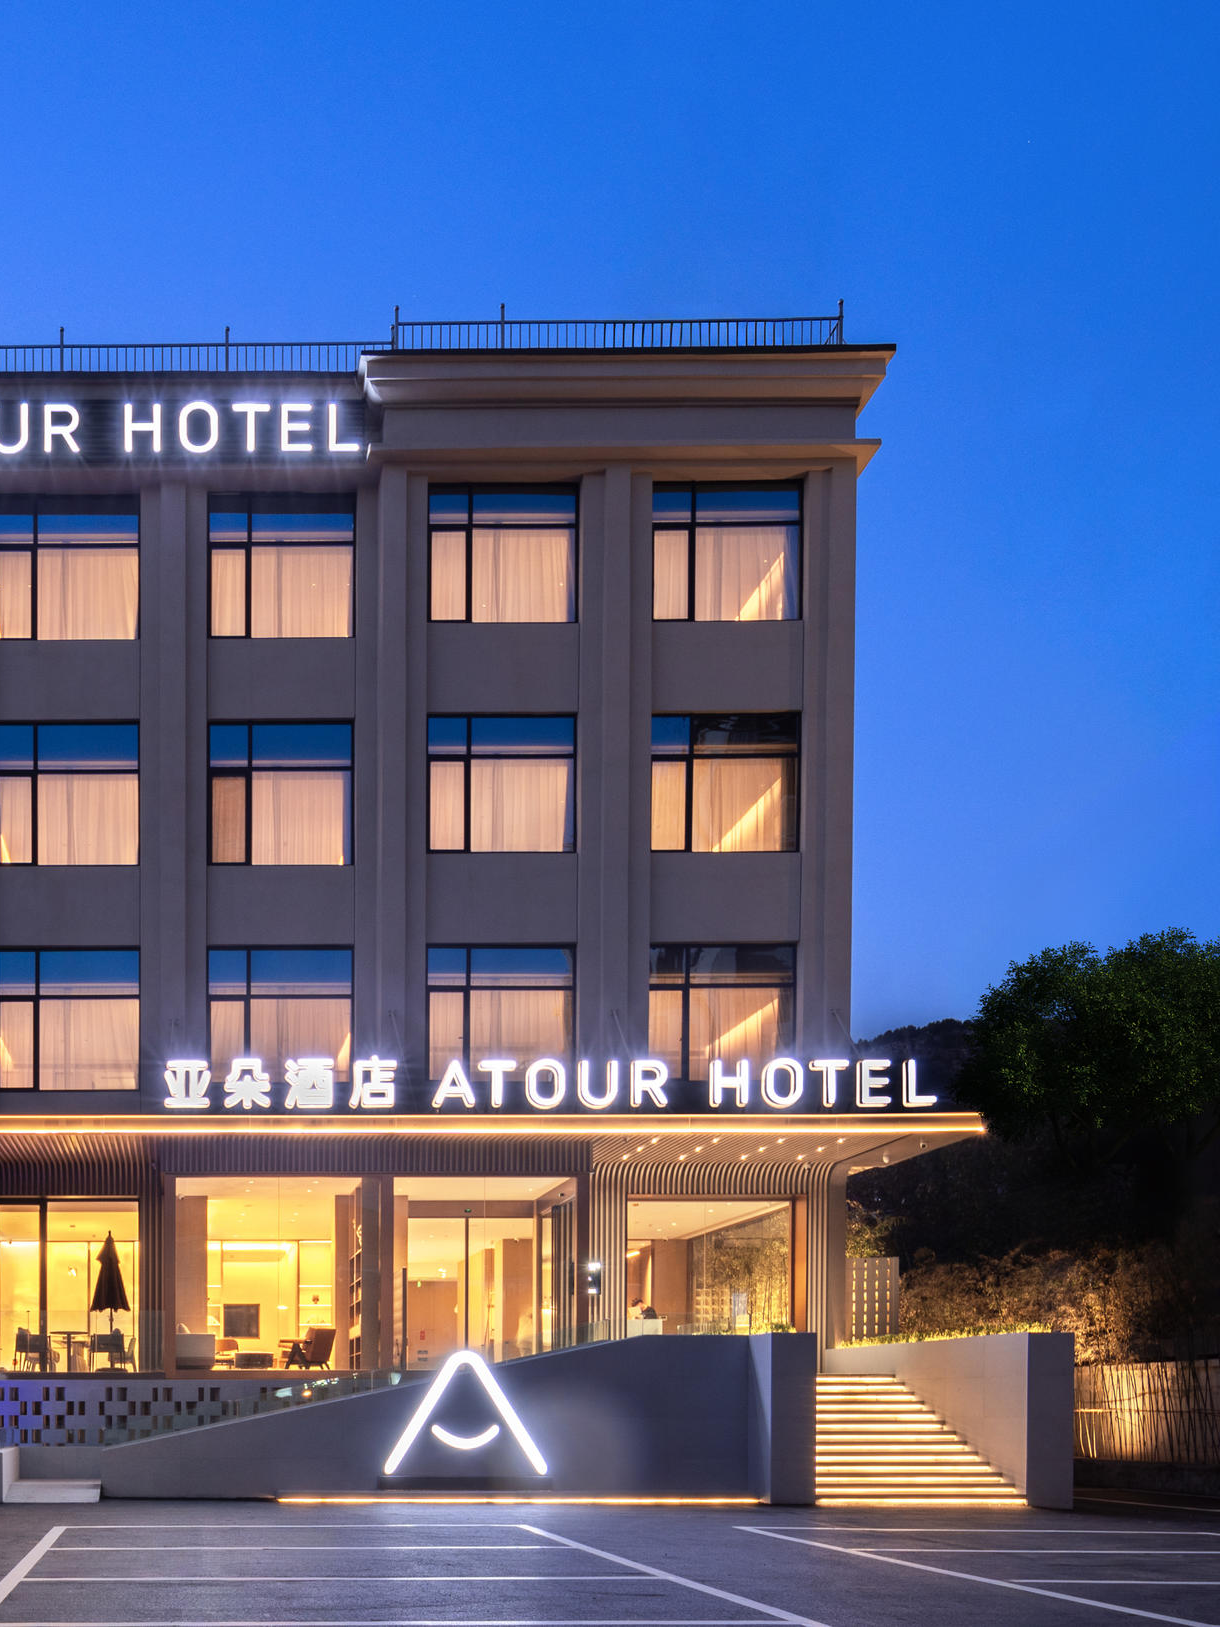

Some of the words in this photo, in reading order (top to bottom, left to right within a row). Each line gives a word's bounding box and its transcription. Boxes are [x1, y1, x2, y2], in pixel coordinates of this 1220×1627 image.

[123, 401, 361, 454] HOTEL
[163, 1054, 398, 1110] 亚朵酒店
[432, 1057, 670, 1110] ATOUR
[708, 1057, 939, 1109] HOTEL
